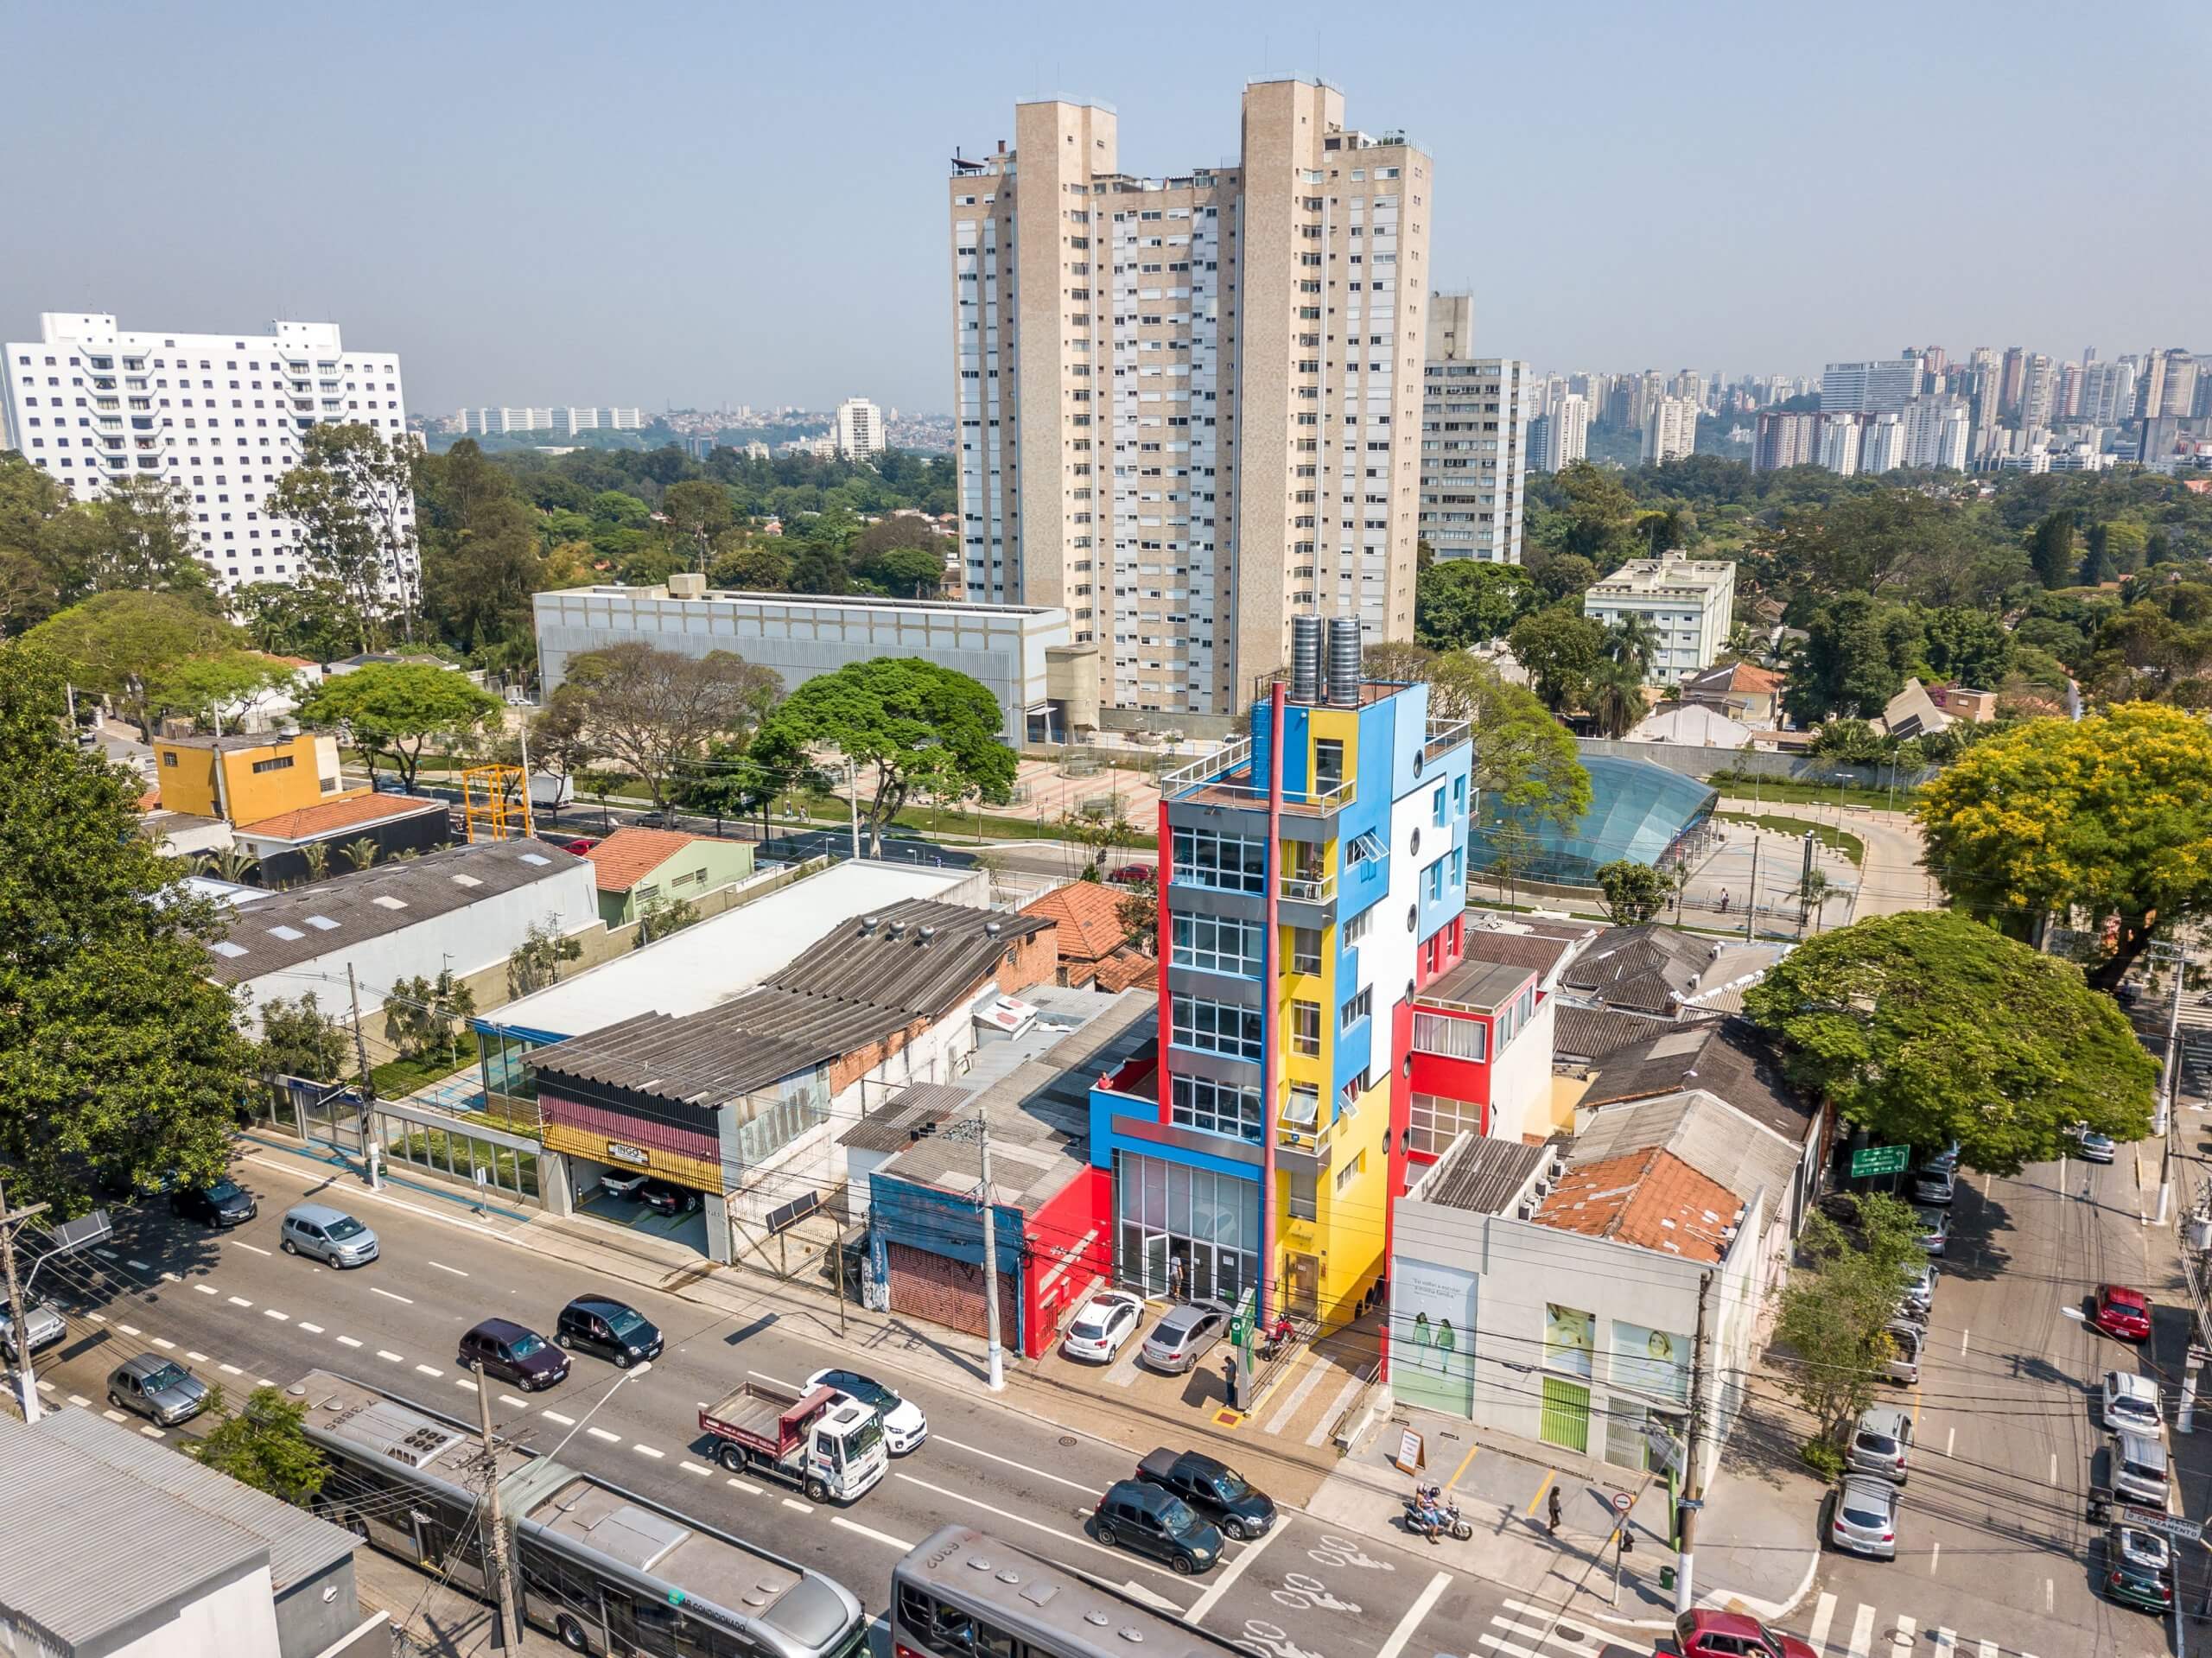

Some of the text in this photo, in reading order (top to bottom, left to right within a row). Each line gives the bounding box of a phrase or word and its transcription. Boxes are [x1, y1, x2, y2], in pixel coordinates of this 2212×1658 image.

[324, 1406, 364, 1431] 3885
[2137, 1515, 2197, 1537] CRUZAMENTO
[927, 1542, 960, 1569] 6302
[693, 1603, 747, 1633] CONDICIONADO
